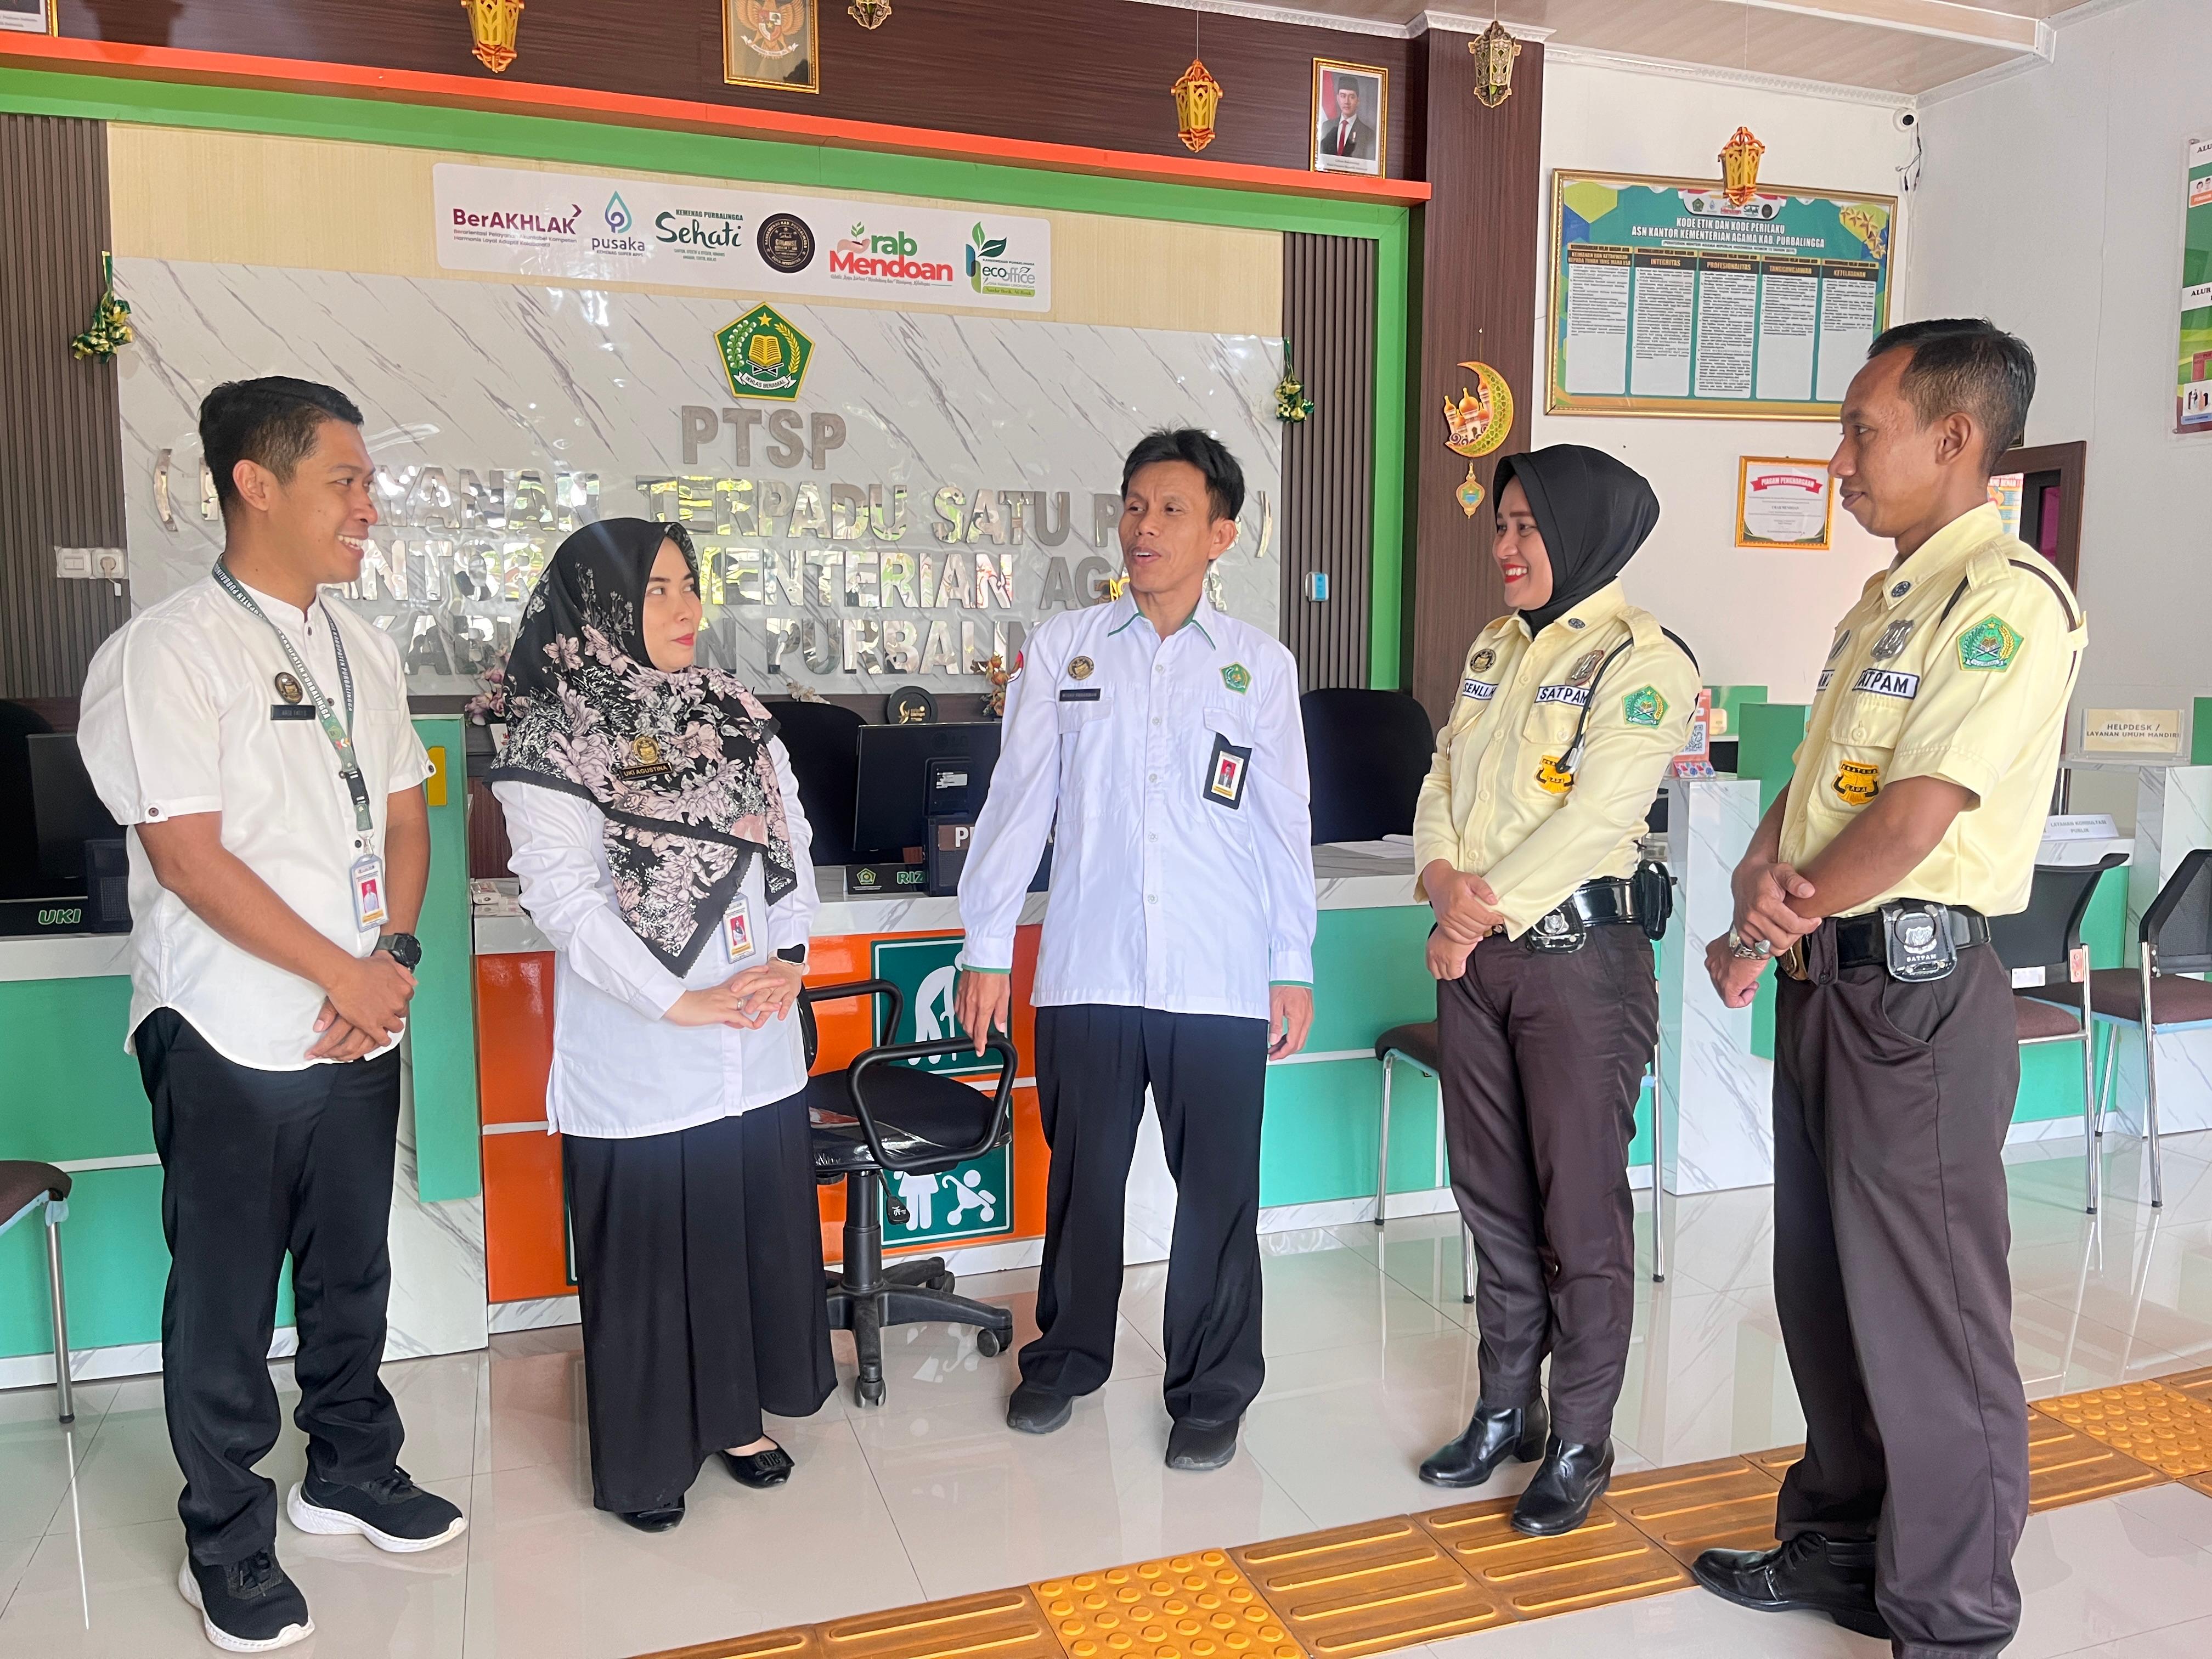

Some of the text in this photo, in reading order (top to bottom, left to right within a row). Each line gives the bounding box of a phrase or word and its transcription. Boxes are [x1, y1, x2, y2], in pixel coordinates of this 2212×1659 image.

[453, 208, 576, 234] BerAKHLAK
[656, 212, 742, 249] Sehati
[1677, 217, 1785, 234] KODE ETIK DAN KODE PERILAKU
[592, 237, 645, 251] pusaka
[1632, 226, 1646, 236] ASN
[1649, 227, 1678, 238] KANTOR
[1680, 229, 1729, 241] KEMENTERIAN
[1731, 232, 1757, 243] AGAMA
[1776, 236, 1825, 248] PURBALINGGA
[830, 250, 953, 281] Mendoan
[1650, 258, 1681, 267] INTEGRITAS
[1707, 261, 1751, 270] PROFESIONALITAS
[2191, 287, 2210, 296] ALUR
[745, 376, 786, 389] IKHLAS BERAMAL
[682, 405, 846, 470] PTSP
[1761, 477, 1779, 486] PIAGAM
[635, 475, 907, 541] TERPADU
[933, 486, 1070, 547] SATU
[336, 539, 544, 602] NTOR
[699, 547, 1012, 609] ENTERIAN
[766, 618, 1041, 675] PURBALIN
[280, 634, 331, 720] KABUPATEN PURBALINGGA
[1857, 671, 1909, 694] ATPAM
[341, 666, 352, 712] PURBALINGGA
[636, 765, 668, 775] AGUSTINA
[38, 909, 81, 925] UKI
[1906, 954, 1937, 962] SATPAM
